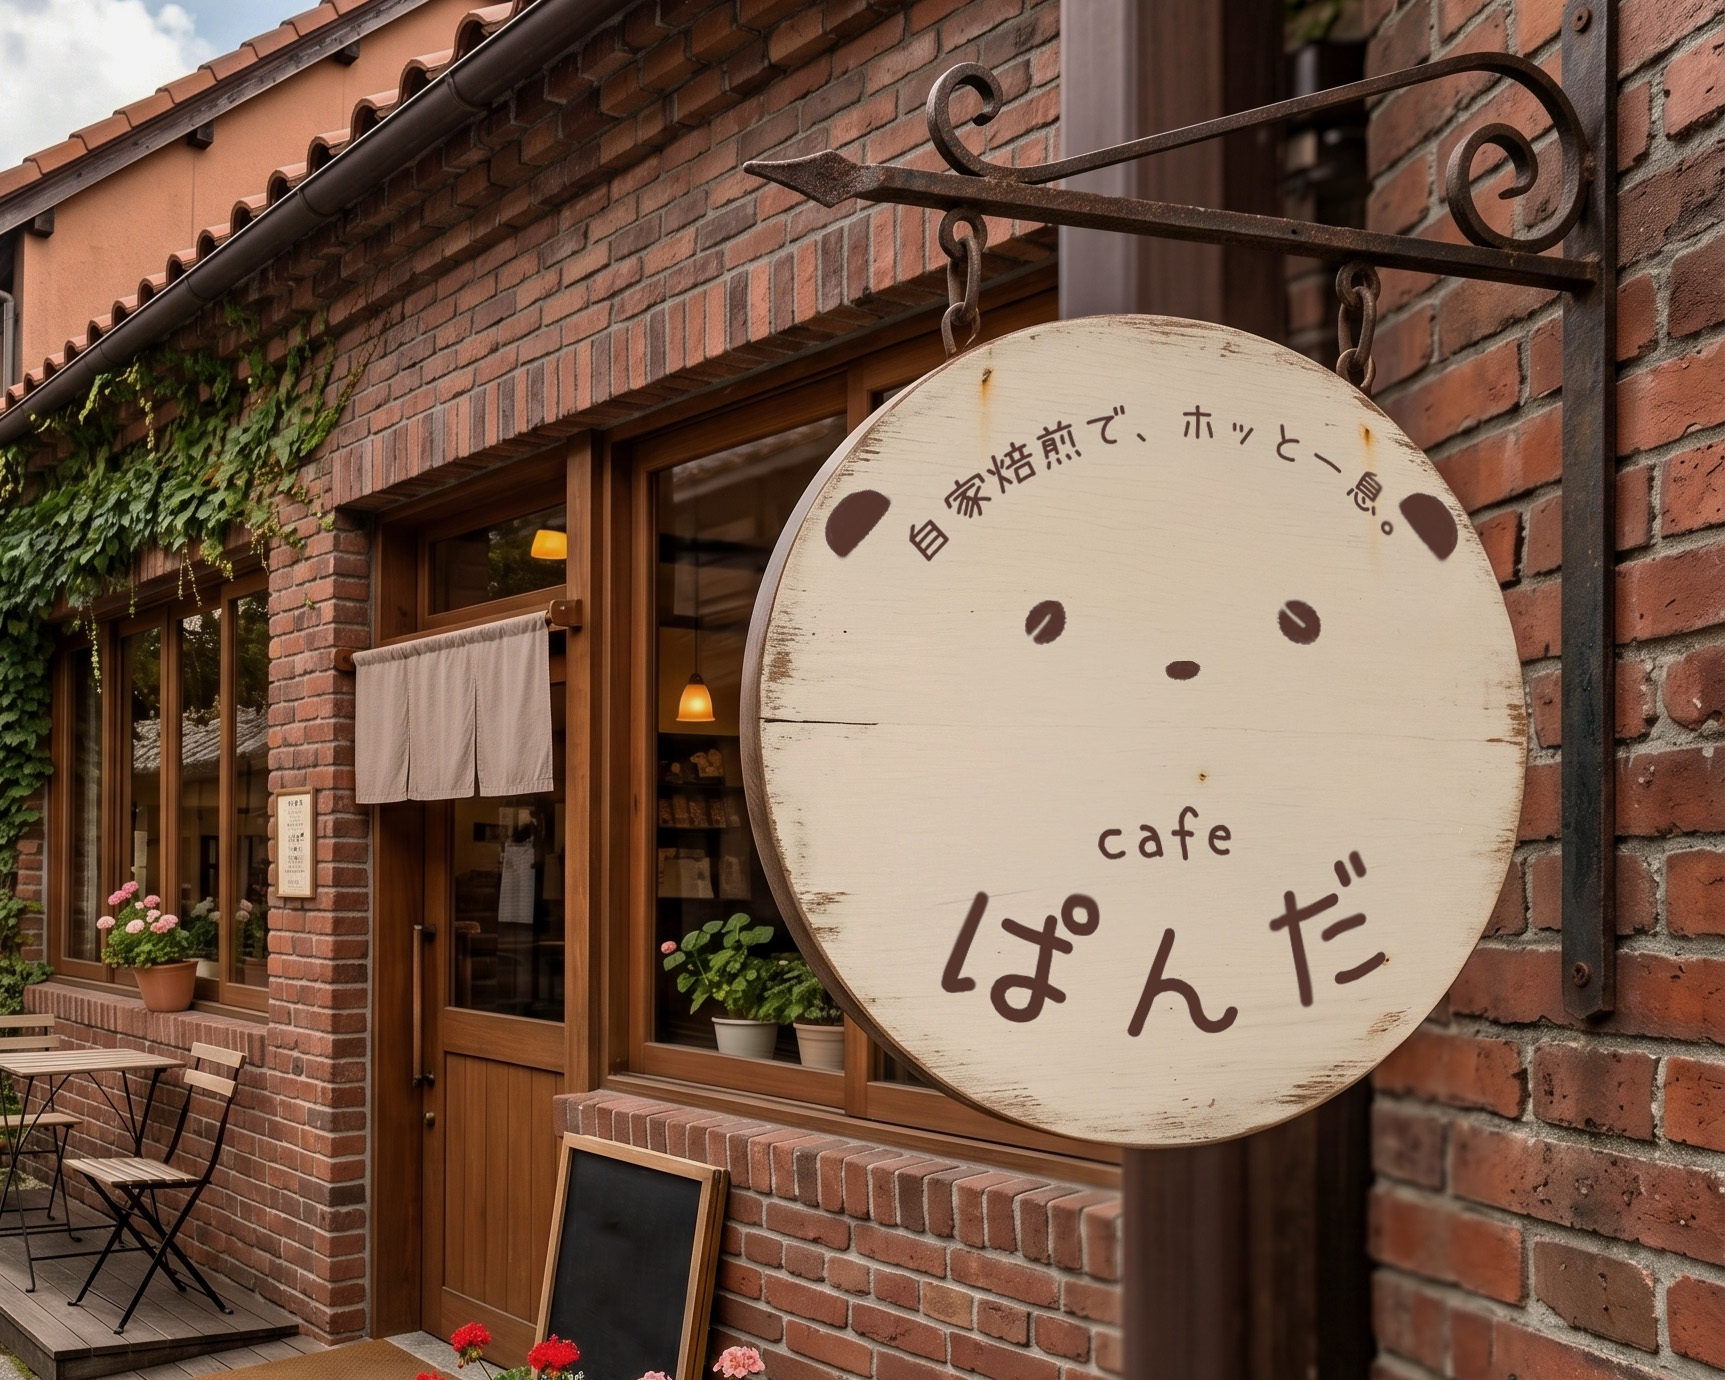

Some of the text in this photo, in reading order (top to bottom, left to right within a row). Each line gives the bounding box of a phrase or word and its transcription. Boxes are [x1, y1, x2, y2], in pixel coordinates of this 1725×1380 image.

[1098, 805, 1232, 862] cafe
[941, 850, 1387, 1037] ぱんだ
